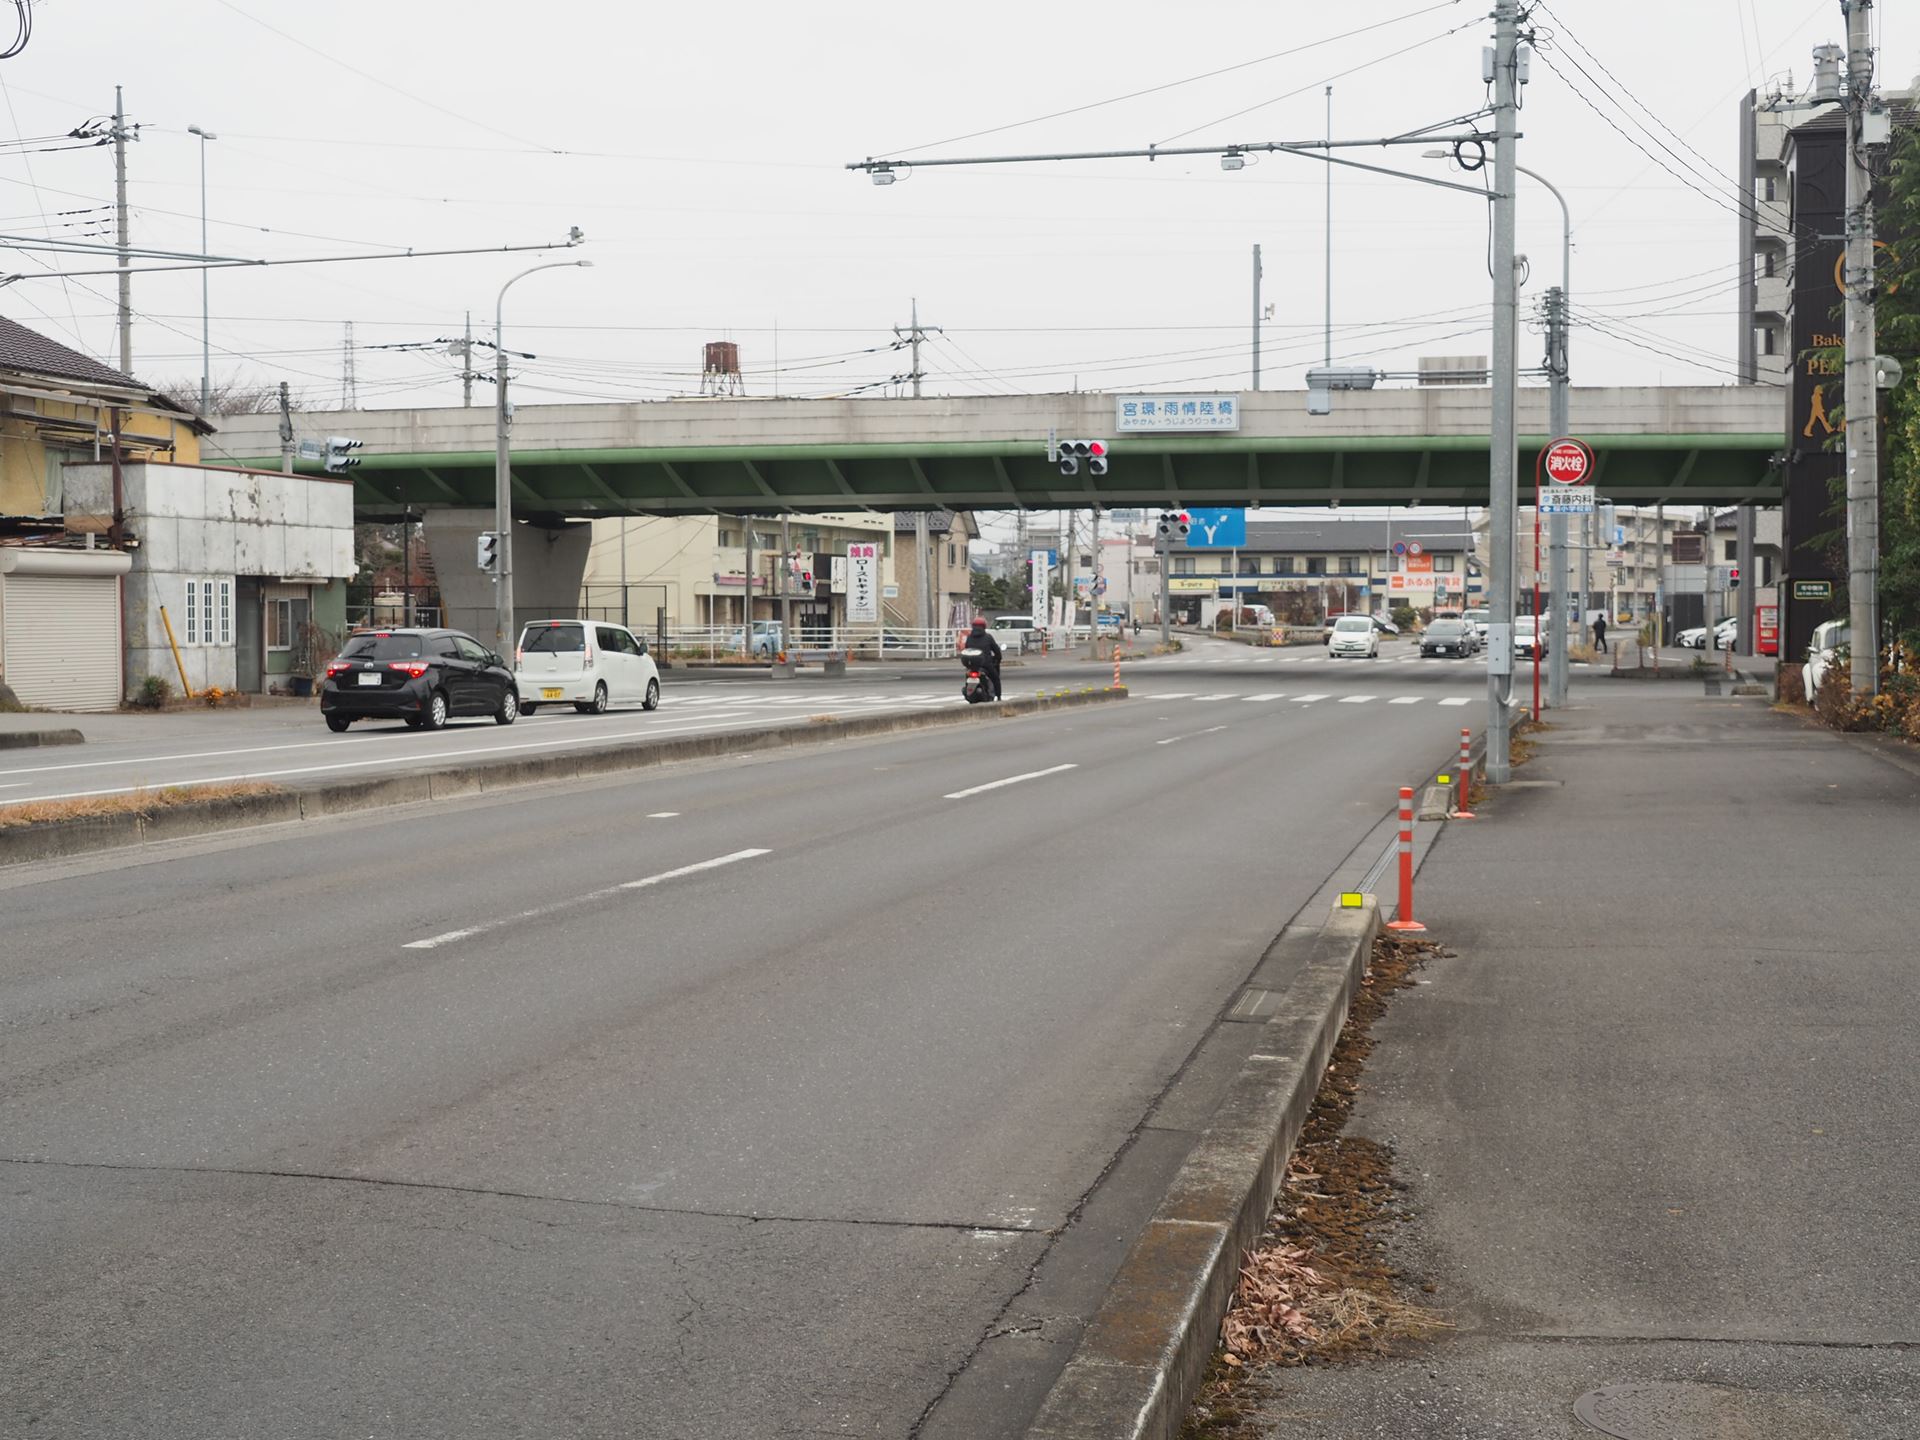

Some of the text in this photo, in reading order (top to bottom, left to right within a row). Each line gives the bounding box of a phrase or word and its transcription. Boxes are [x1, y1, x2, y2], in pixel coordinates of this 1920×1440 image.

[1123, 401, 1233, 417] 宮環・雨情陸橋
[1550, 455, 1583, 472] 消火栓
[850, 546, 874, 558] 焼肉
[856, 559, 868, 608] ローストキッチン
